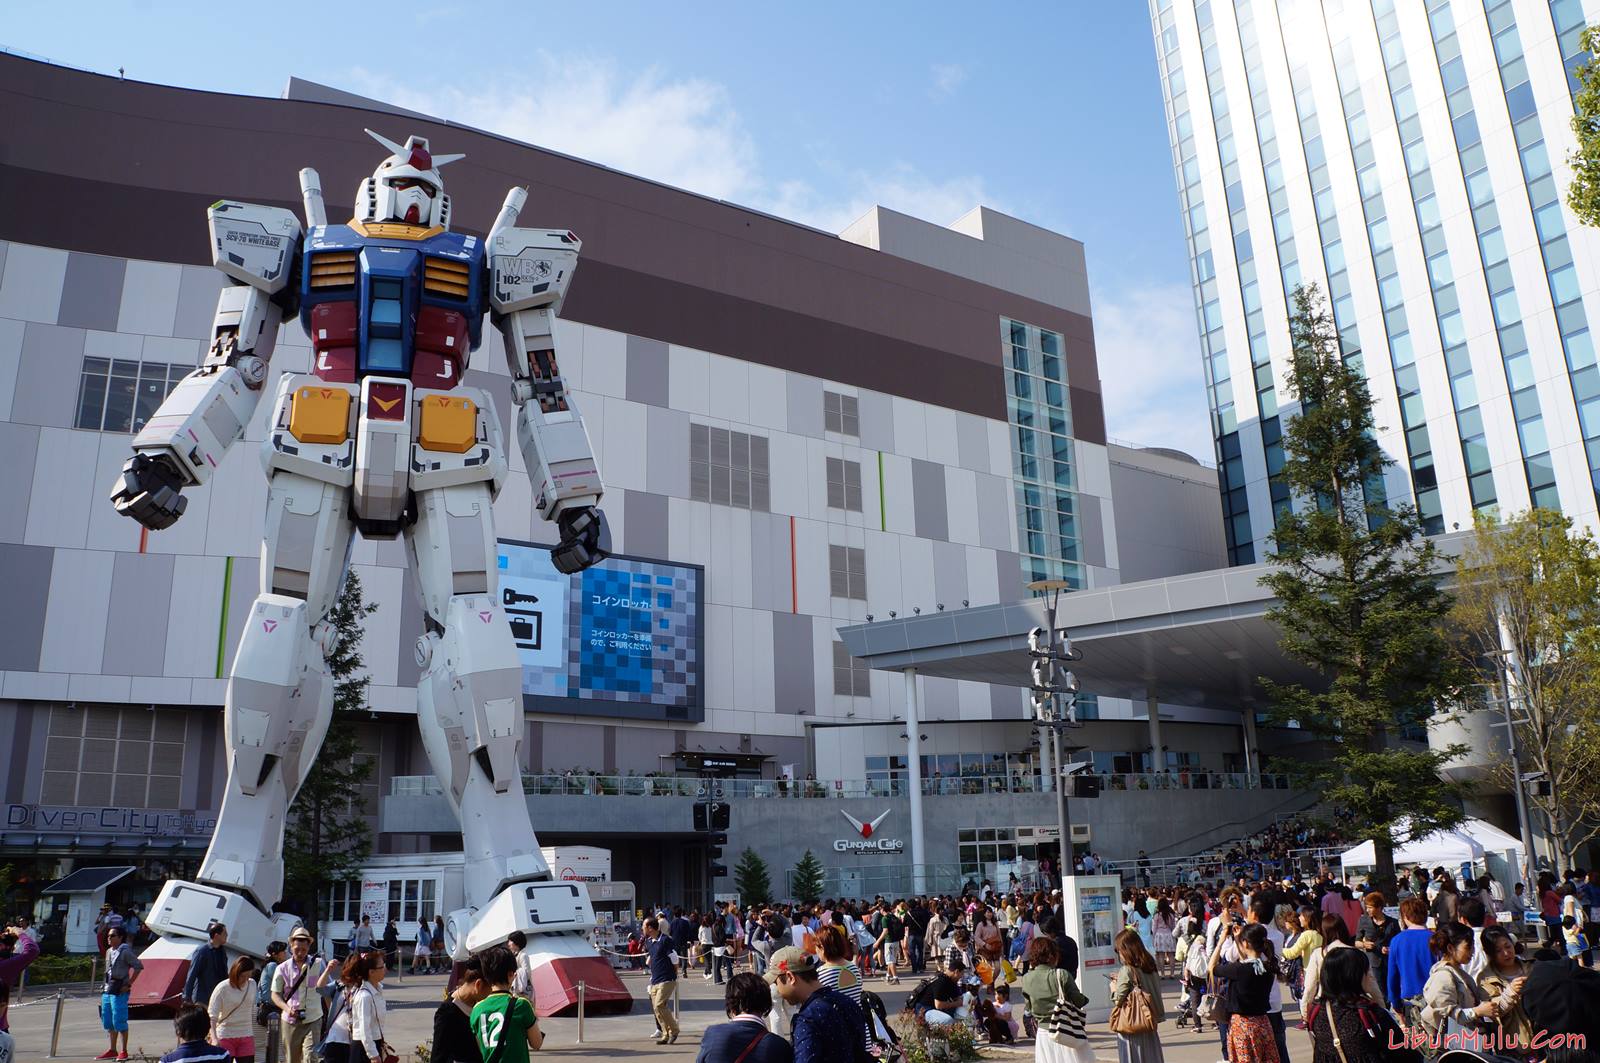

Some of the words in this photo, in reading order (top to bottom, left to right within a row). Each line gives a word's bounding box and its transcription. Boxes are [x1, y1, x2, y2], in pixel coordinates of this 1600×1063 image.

[226, 233, 247, 243] SCV-70
[248, 237, 280, 248] WHITEBASE
[503, 275, 521, 285] 102
[7, 804, 160, 835] DiverCity
[480, 1011, 507, 1048] 12
